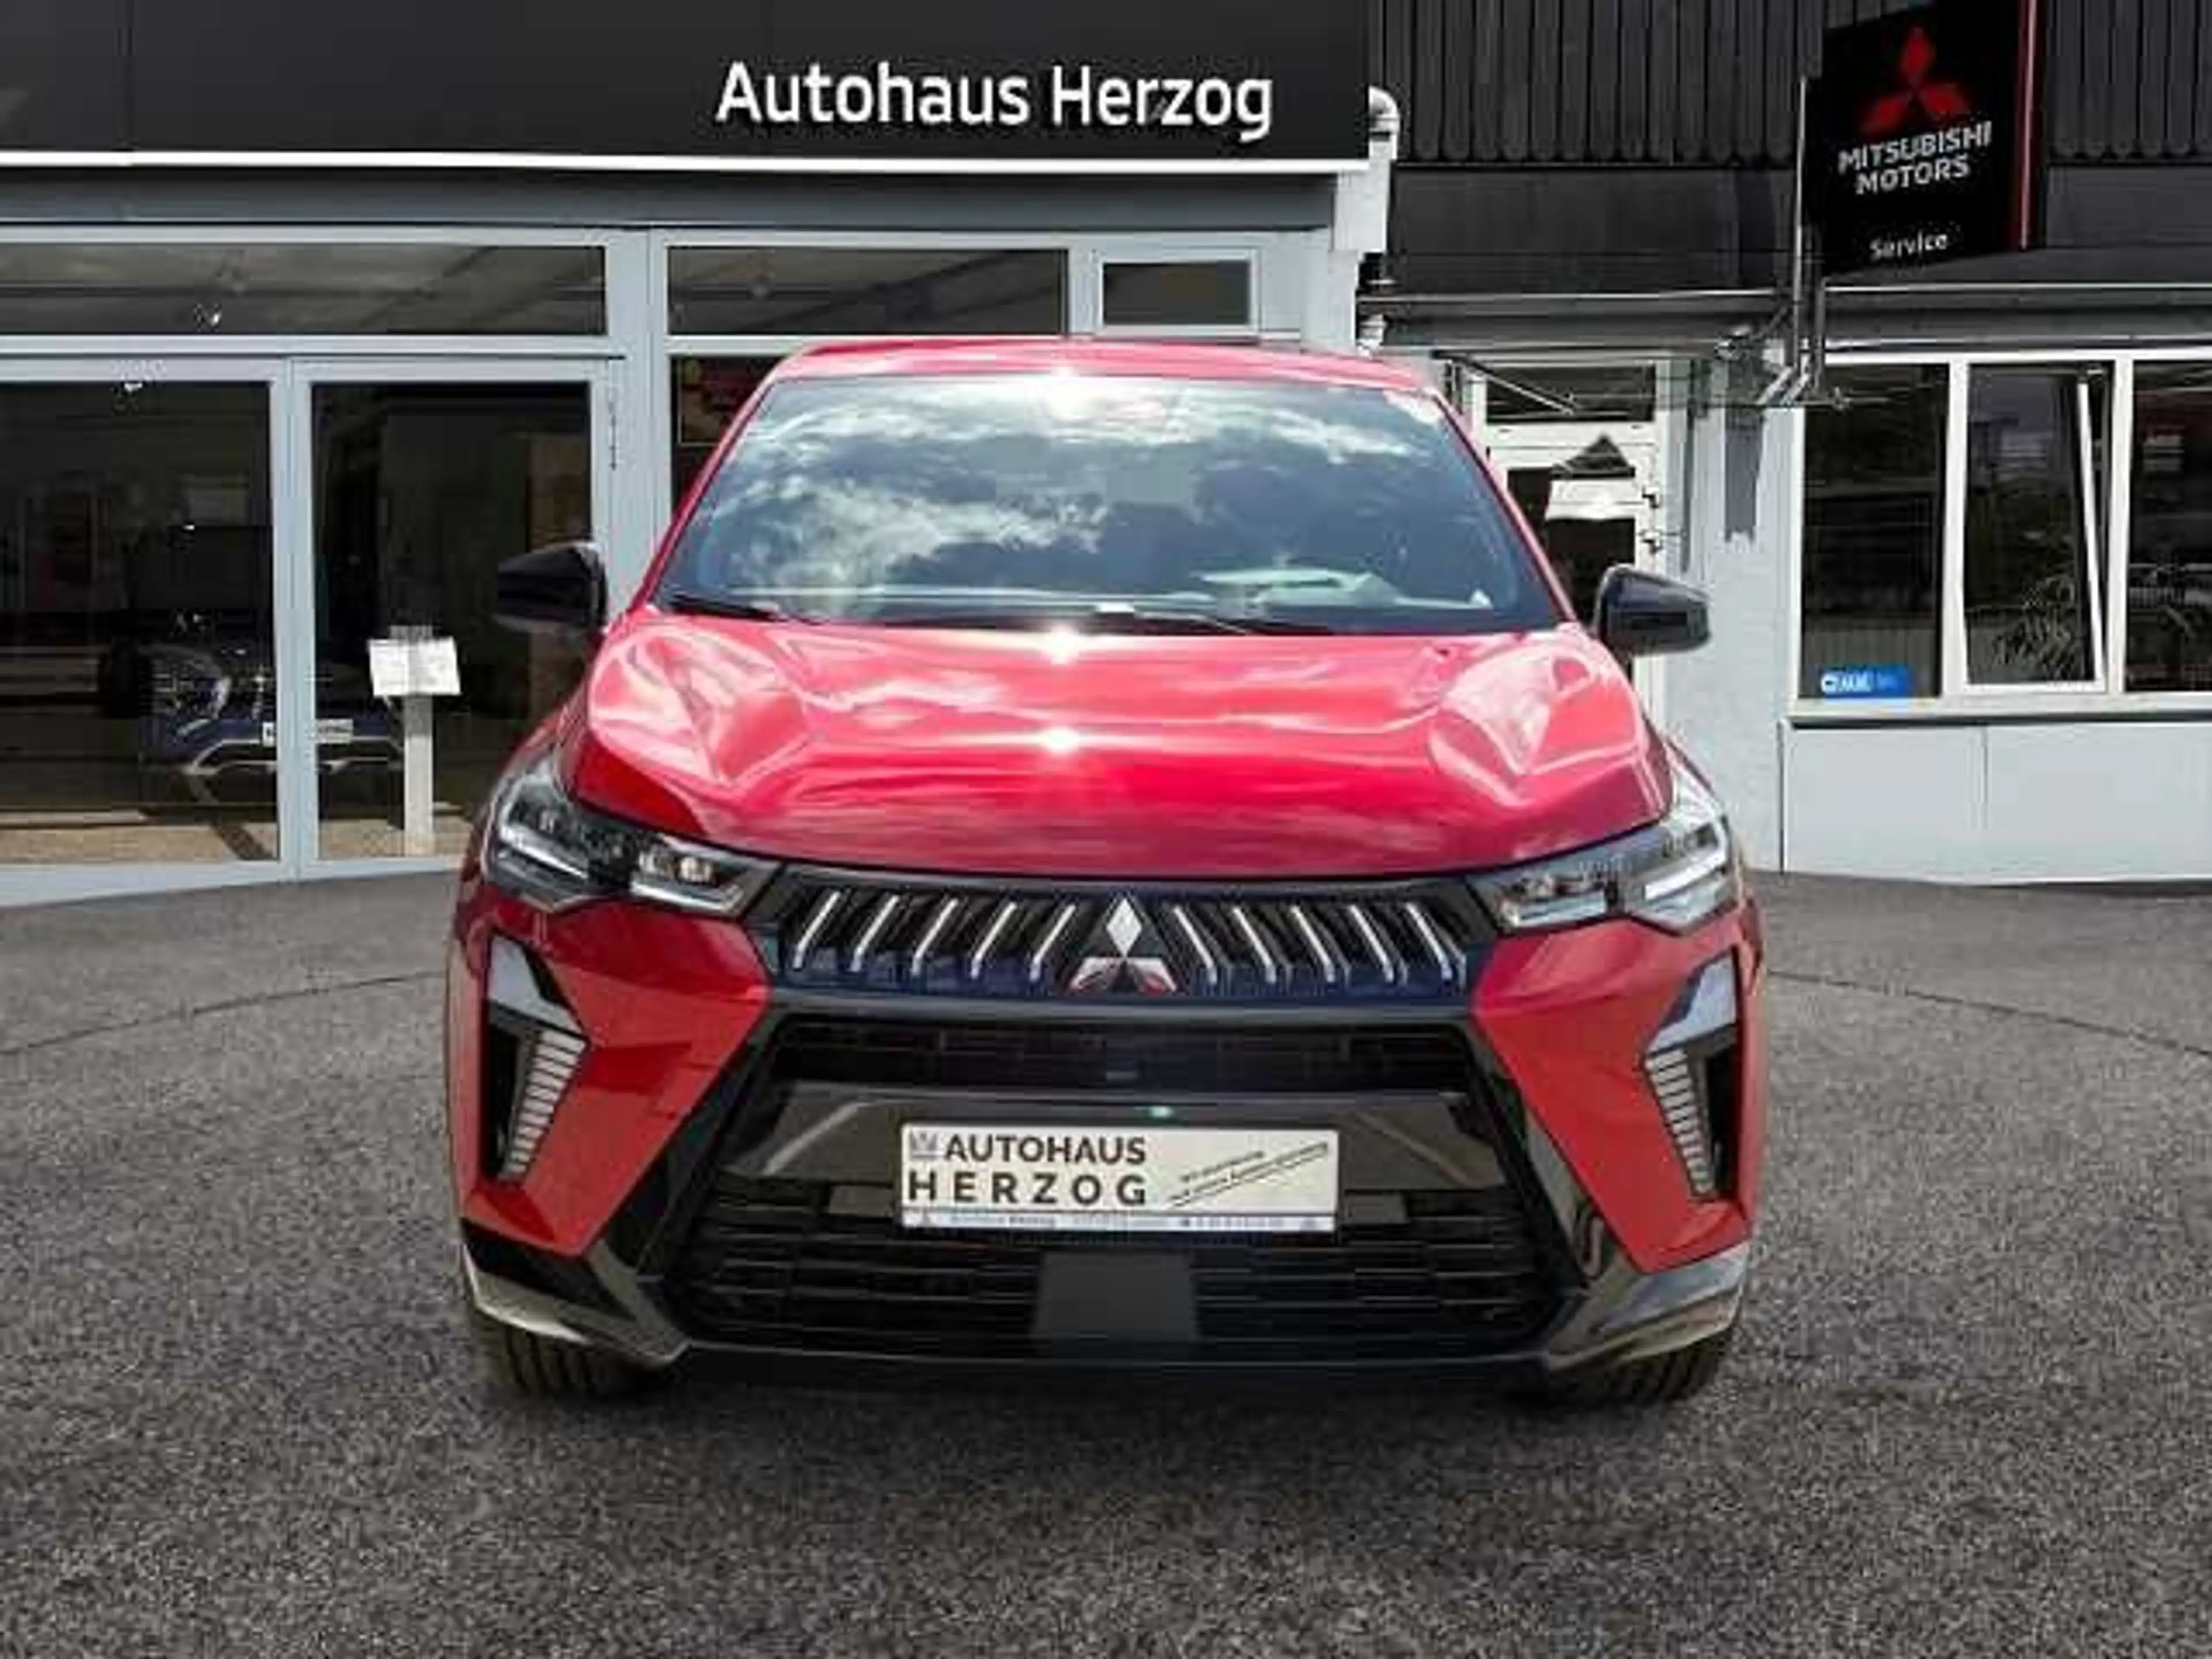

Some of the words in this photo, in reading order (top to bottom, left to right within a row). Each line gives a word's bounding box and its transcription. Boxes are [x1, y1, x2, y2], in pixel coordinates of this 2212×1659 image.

[716, 61, 1031, 126] Autohaus
[1052, 65, 1273, 142] Herzog
[1838, 120, 1992, 173] MITSUBISHI
[1855, 153, 1971, 195] MOTORS
[1869, 230, 1948, 262] Service
[944, 1134, 1146, 1164] AUTOHAUS
[908, 1171, 1146, 1205] HERZOG
